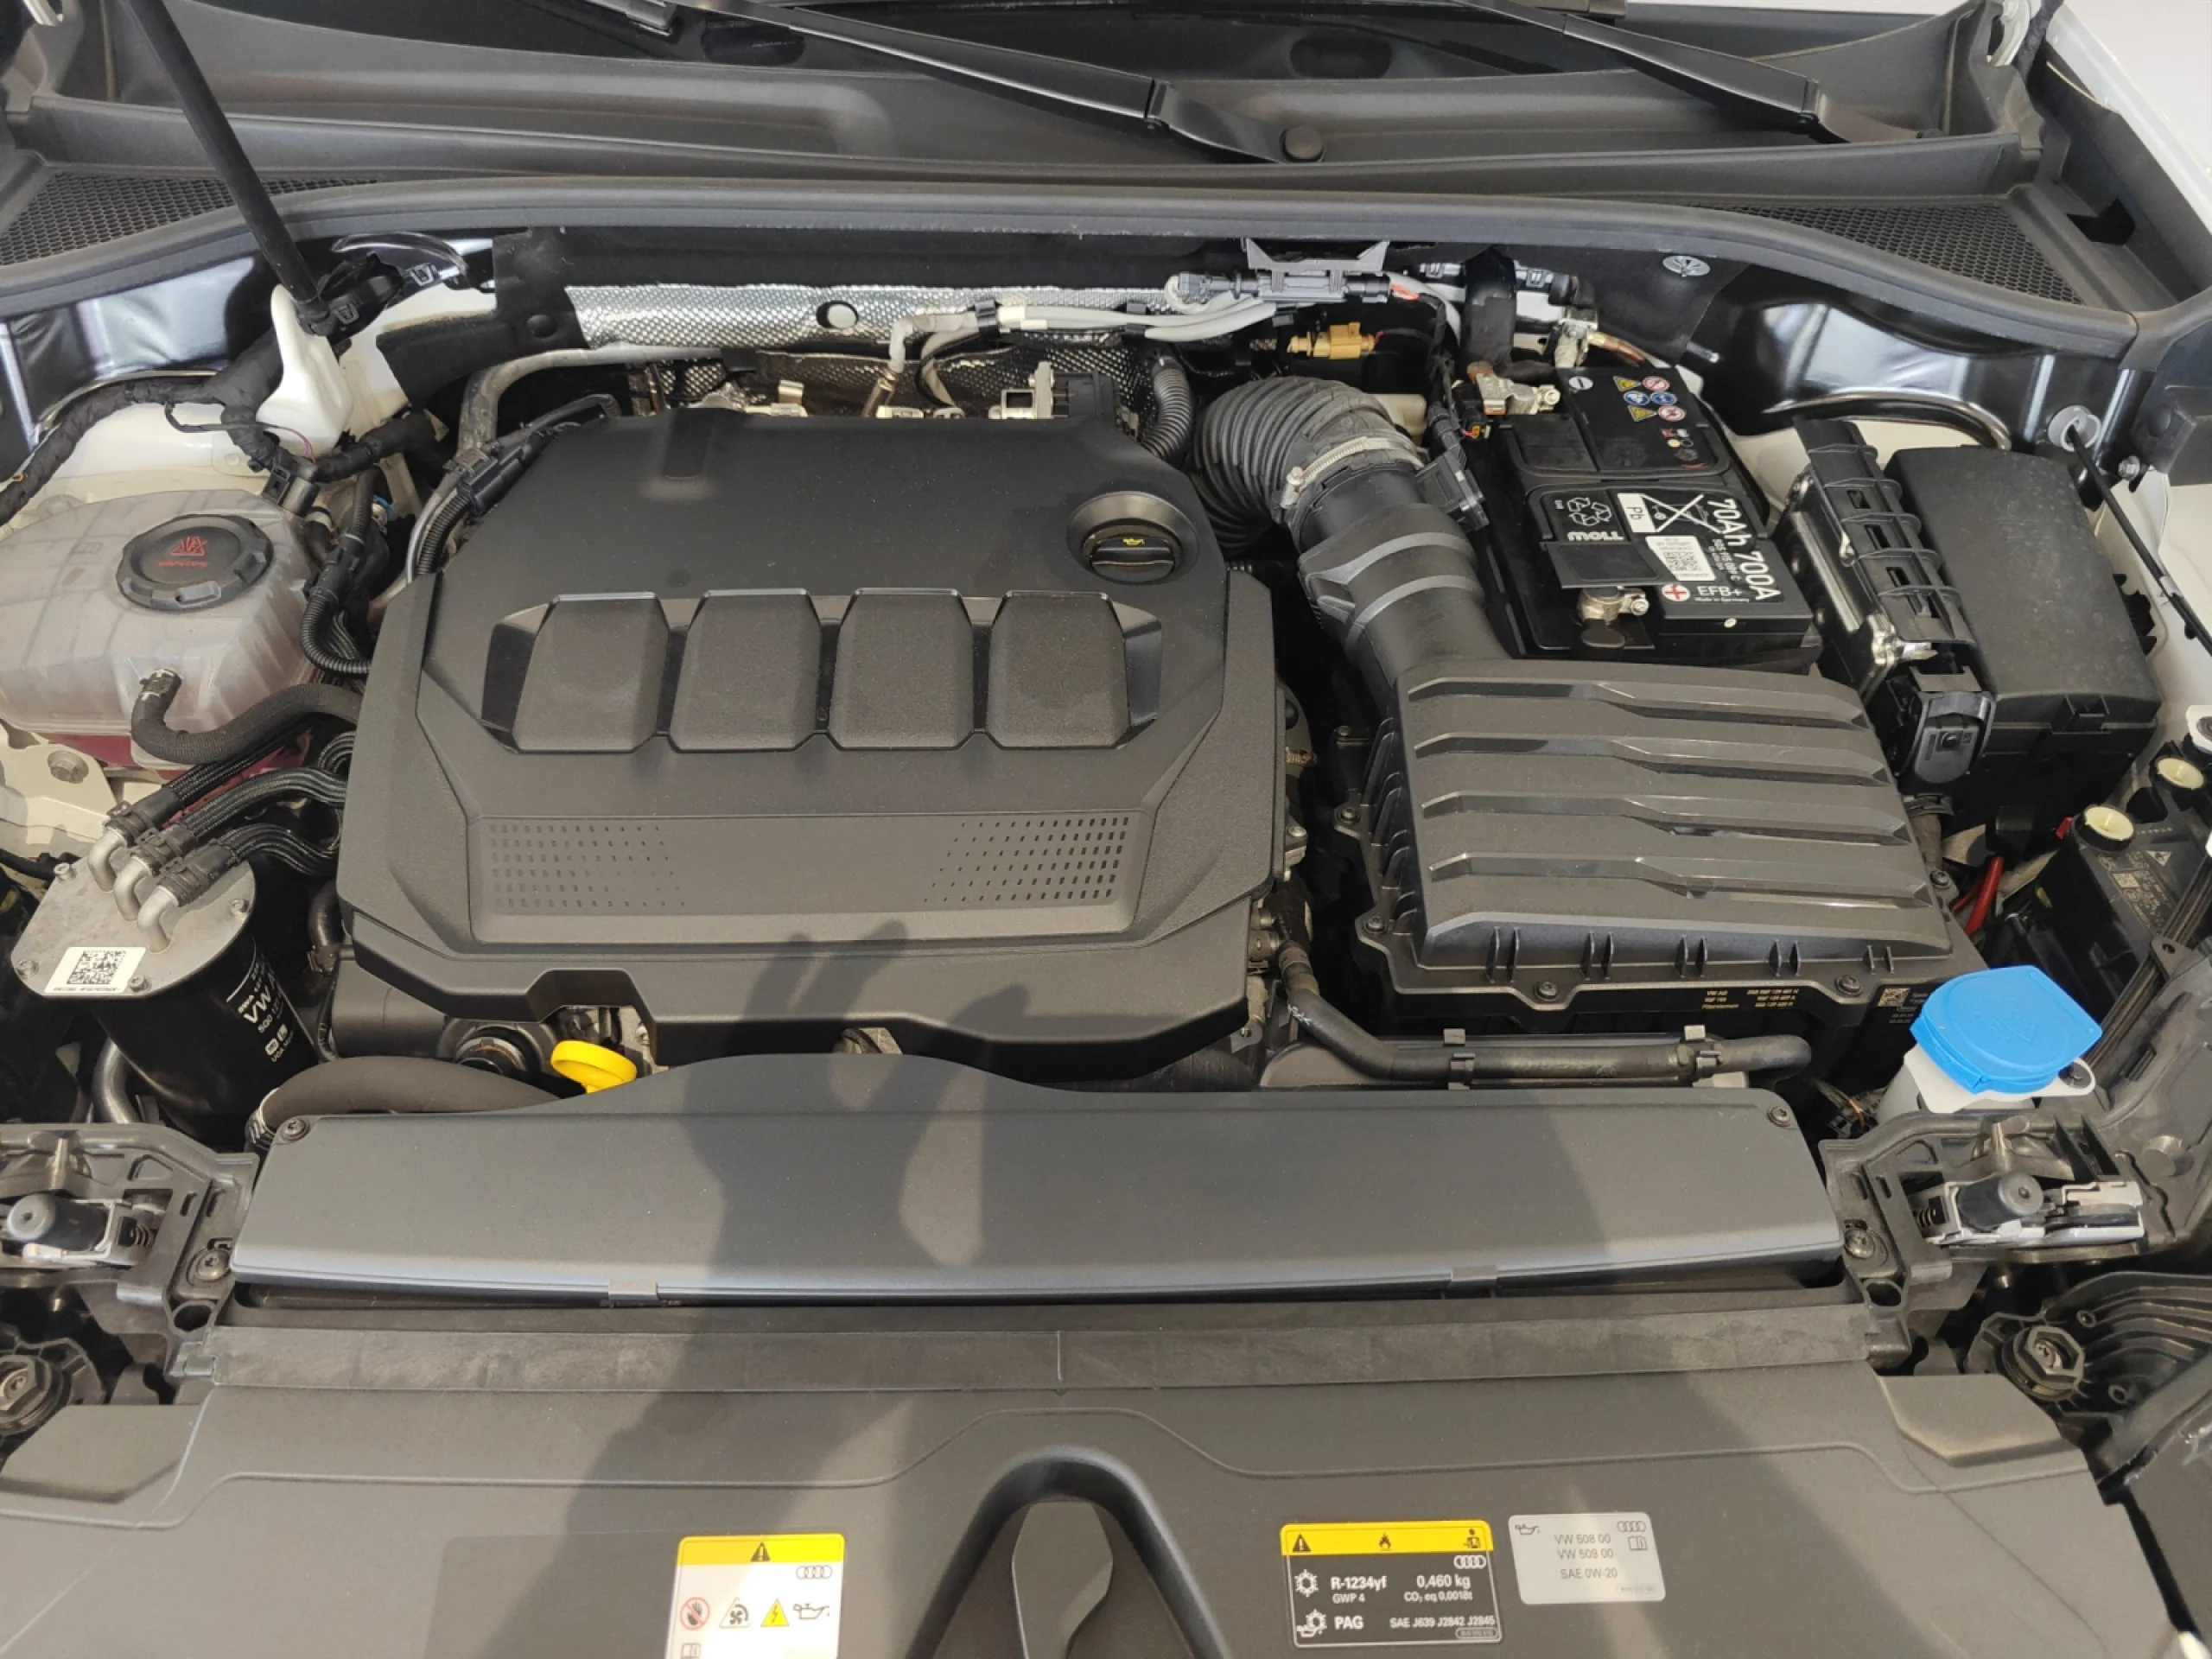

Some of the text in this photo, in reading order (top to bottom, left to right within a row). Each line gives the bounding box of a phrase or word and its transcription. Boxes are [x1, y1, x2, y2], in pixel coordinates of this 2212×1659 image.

[1626, 506, 1645, 520] Pb
[1707, 499, 1751, 546] 70Ah
[1733, 551, 1781, 600] 700A
[243, 985, 271, 1023] VW
[1554, 1534, 1611, 1545] VW 508 00
[1557, 1548, 1614, 1560] VW 509 00
[1560, 1567, 1618, 1580] SAE 0W-20
[1330, 1575, 1388, 1592] R-1234yf
[1416, 1573, 1471, 1591] 0,460 kg
[1332, 1592, 1357, 1604] GWP
[1334, 1615, 1364, 1630] PAG
[1389, 1617, 1410, 1629] SAE
